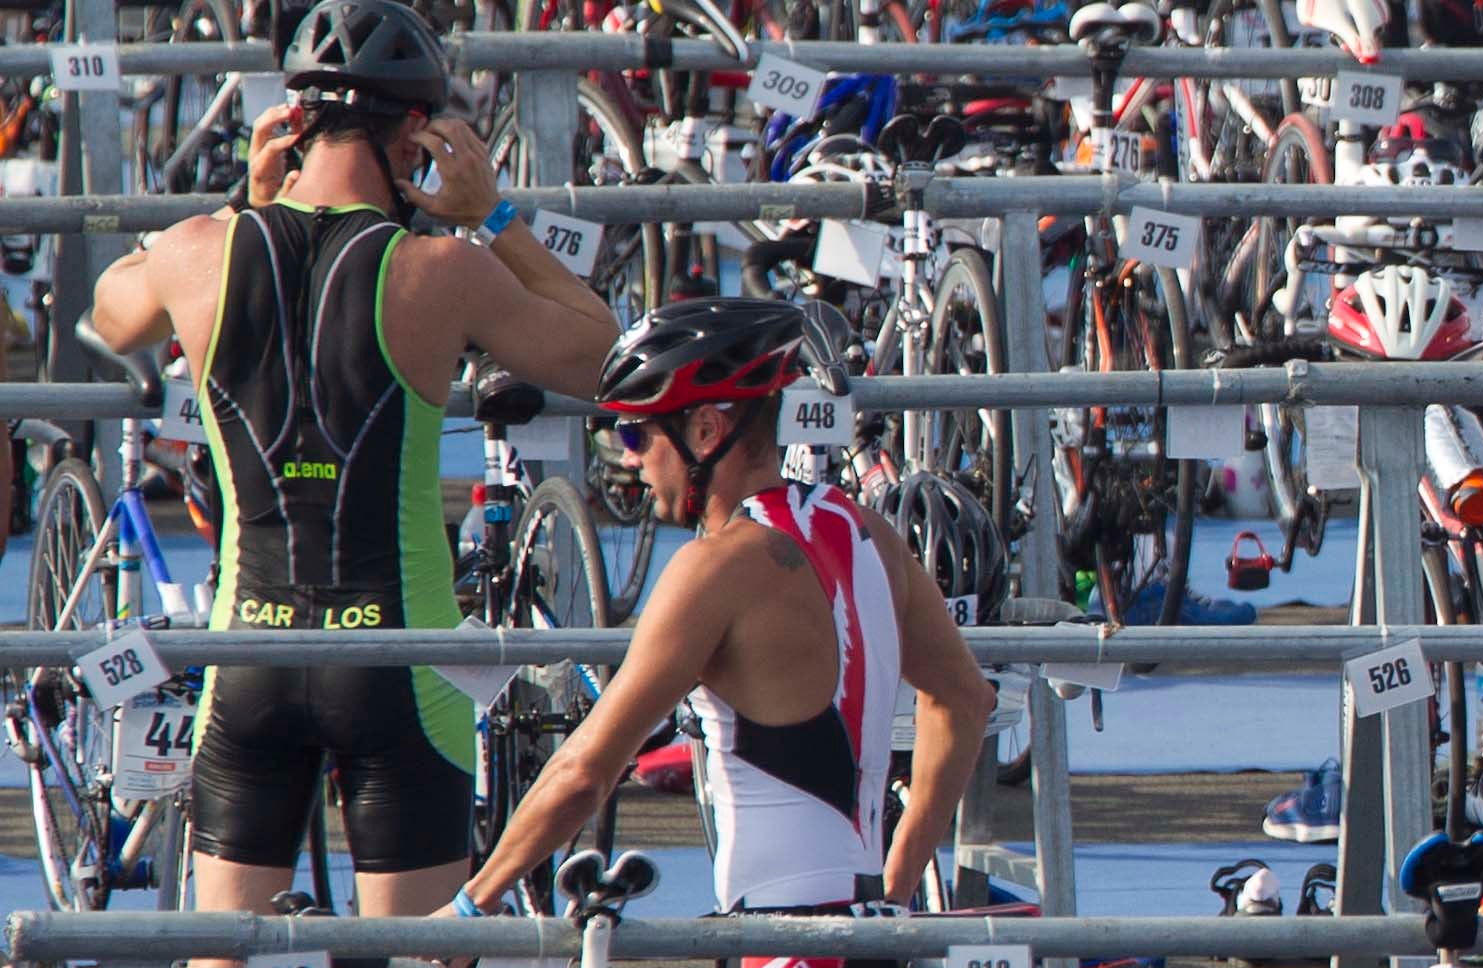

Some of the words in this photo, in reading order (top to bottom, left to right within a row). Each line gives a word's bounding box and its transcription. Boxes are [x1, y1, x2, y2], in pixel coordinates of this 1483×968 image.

[68, 55, 104, 77] 310
[763, 70, 809, 100] 309
[1349, 83, 1384, 111] 308
[1111, 133, 1139, 172] 276
[545, 225, 582, 257] 376
[1141, 222, 1179, 251] 375
[283, 461, 337, 480] aena
[239, 599, 294, 629] CAR
[323, 604, 381, 630] LOS
[99, 648, 145, 687] 528
[1368, 659, 1412, 693] 526
